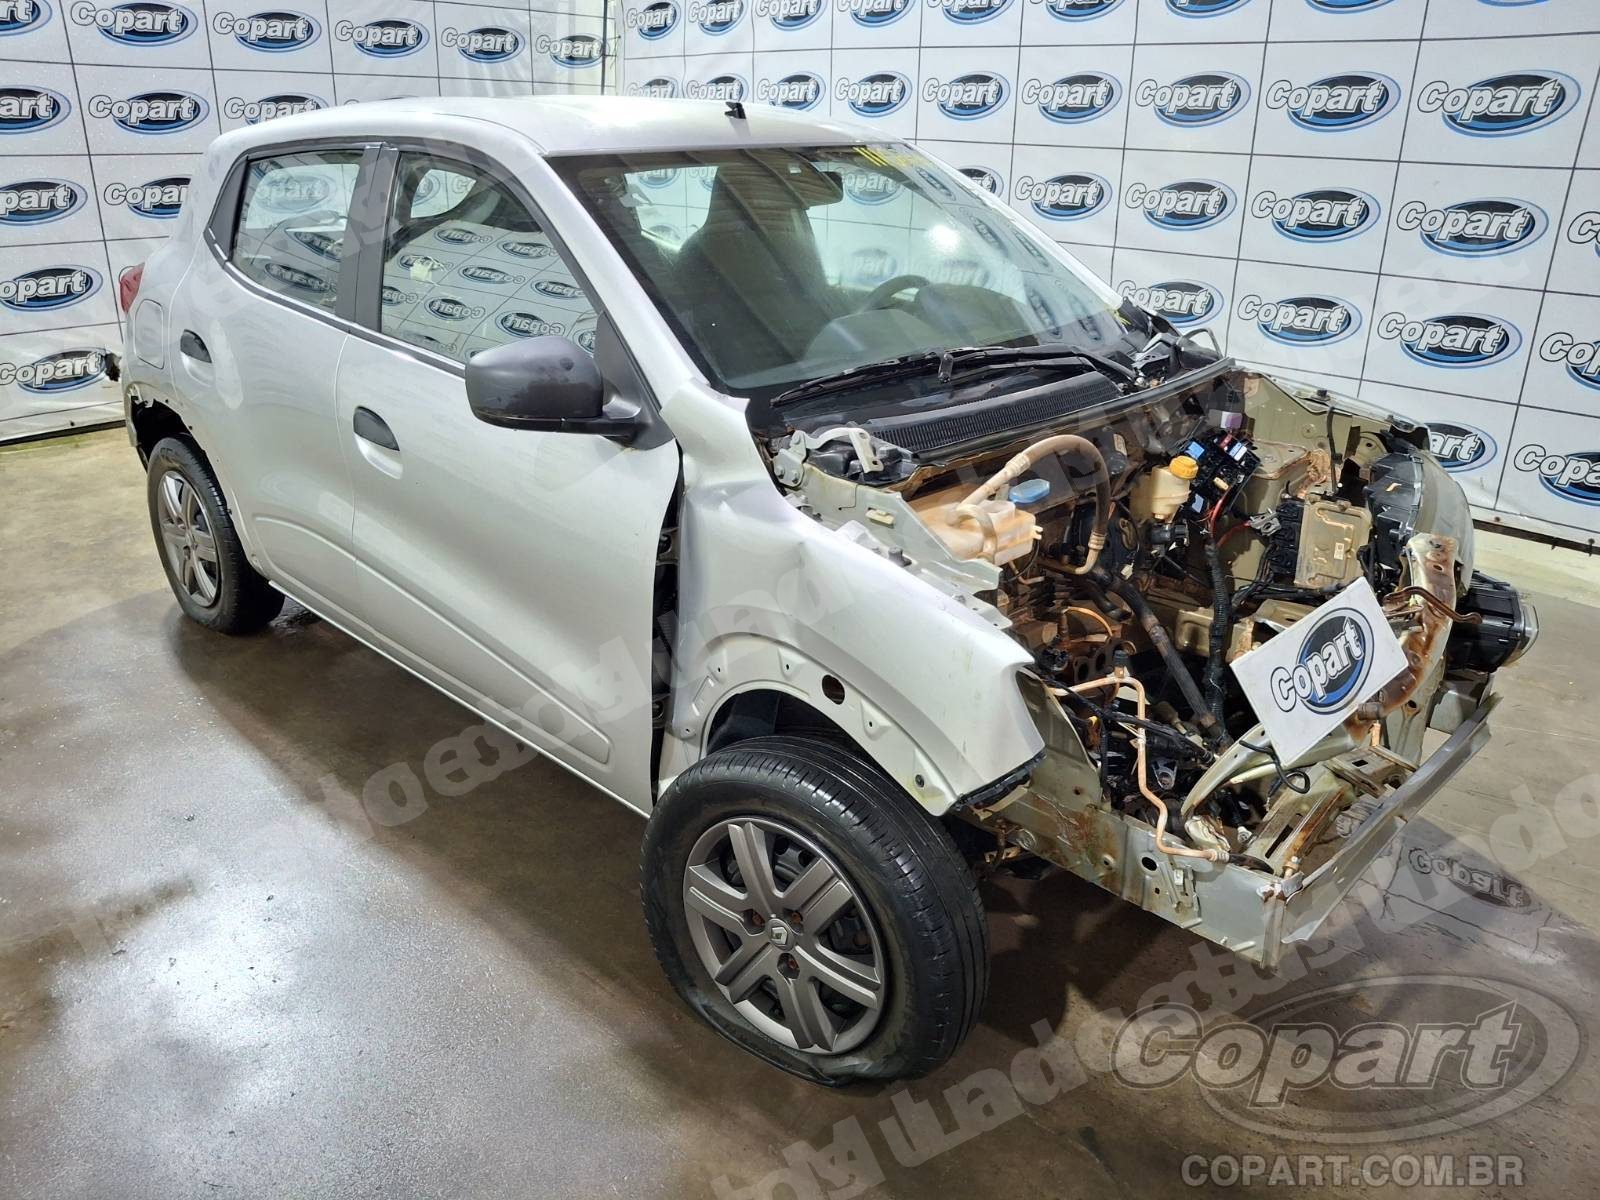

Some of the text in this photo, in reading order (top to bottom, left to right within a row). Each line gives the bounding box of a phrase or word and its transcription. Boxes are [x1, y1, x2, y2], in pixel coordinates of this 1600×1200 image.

[71, 1, 183, 35] Copart
[626, 4, 674, 31] Copart
[688, 0, 740, 26] Copart
[755, 0, 816, 22] Copart
[213, 12, 308, 41] Copart
[335, 20, 418, 46] Copart
[441, 27, 516, 54] Copart
[535, 34, 601, 59] Copart
[686, 79, 741, 101] Copart
[757, 78, 818, 105] Copart
[835, 77, 906, 107] Copart
[922, 78, 999, 108] Copart
[1022, 79, 1108, 111] Copart
[1135, 79, 1241, 115] Copart
[1266, 80, 1386, 118] Copart
[1418, 79, 1559, 121] Copart
[0, 93, 53, 118] art
[88, 95, 195, 124] Copart
[104, 183, 189, 209] Copa
[843, 172, 898, 196] opart
[1015, 176, 1103, 208] Copart
[0, 184, 70, 215] part
[1125, 183, 1224, 218] Copart
[1251, 191, 1366, 228] Copart
[1397, 200, 1530, 241] Copart
[0, 270, 86, 304] opart
[1237, 295, 1350, 332] Copart
[1377, 312, 1505, 353] Copart
[0, 352, 101, 387] Copart
[1430, 433, 1481, 463] art
[1269, 617, 1364, 712] Copart
